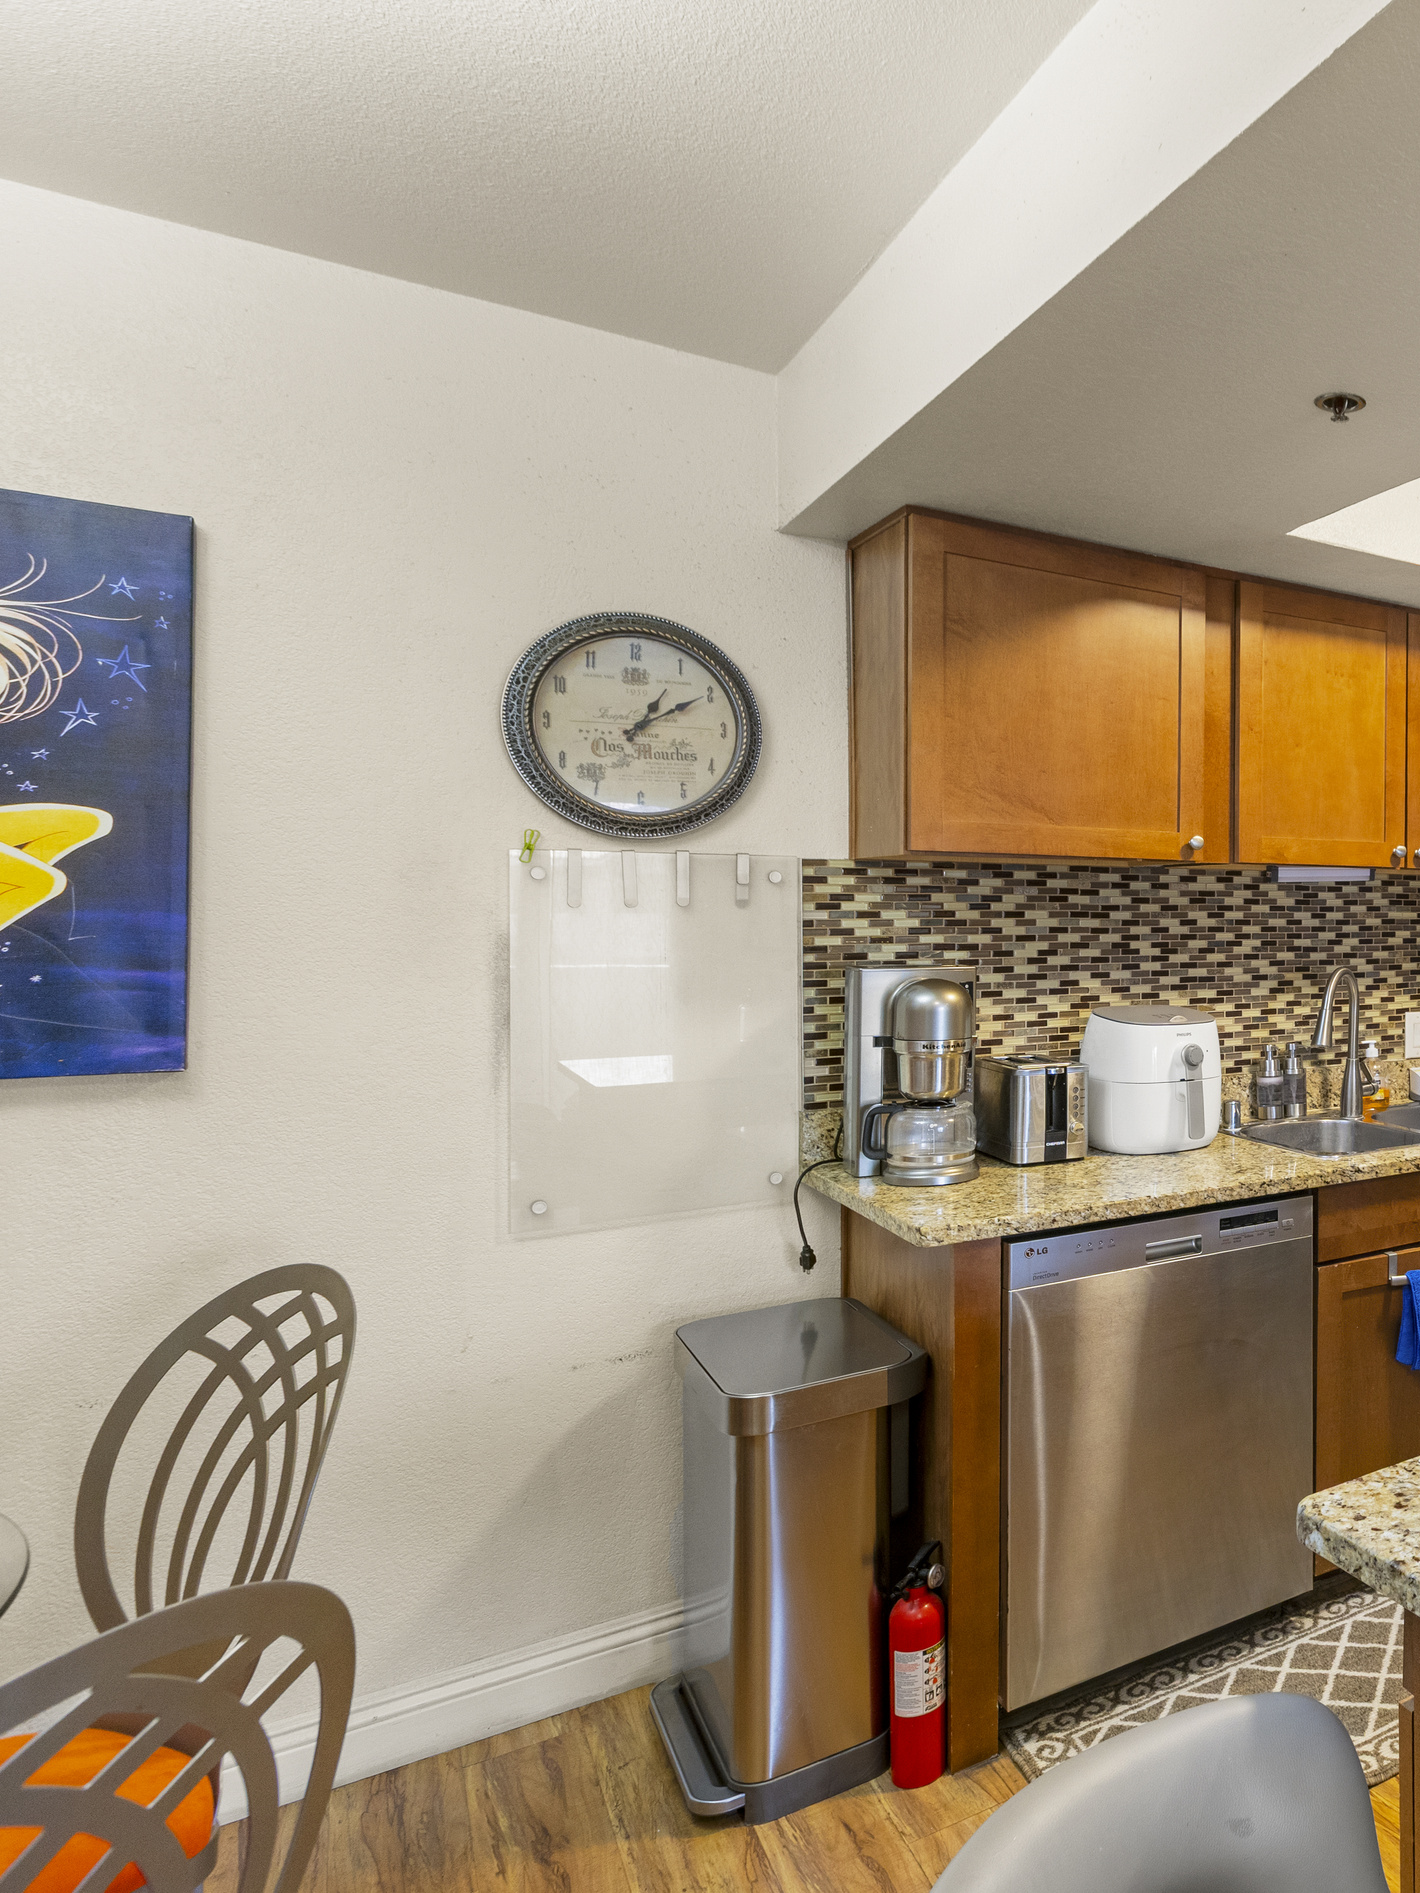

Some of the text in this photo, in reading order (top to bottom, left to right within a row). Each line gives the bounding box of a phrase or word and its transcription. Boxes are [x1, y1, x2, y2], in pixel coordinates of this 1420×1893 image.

[585, 650, 596, 670] 11
[629, 642, 642, 662] 12
[677, 657, 684, 676] 1
[553, 675, 567, 695] 10
[707, 685, 714, 704] 2
[542, 710, 550, 730] 9
[720, 721, 727, 740] 3
[590, 737, 624, 758] Clos
[631, 743, 698, 763] Mouches
[558, 750, 566, 770] 8
[707, 757, 716, 777] 4
[680, 782, 687, 800] 5
[922, 1042, 966, 1050] KitchenAid
[1036, 1247, 1048, 1255] LG
[1033, 1272, 1059, 1280] DirectDrive
